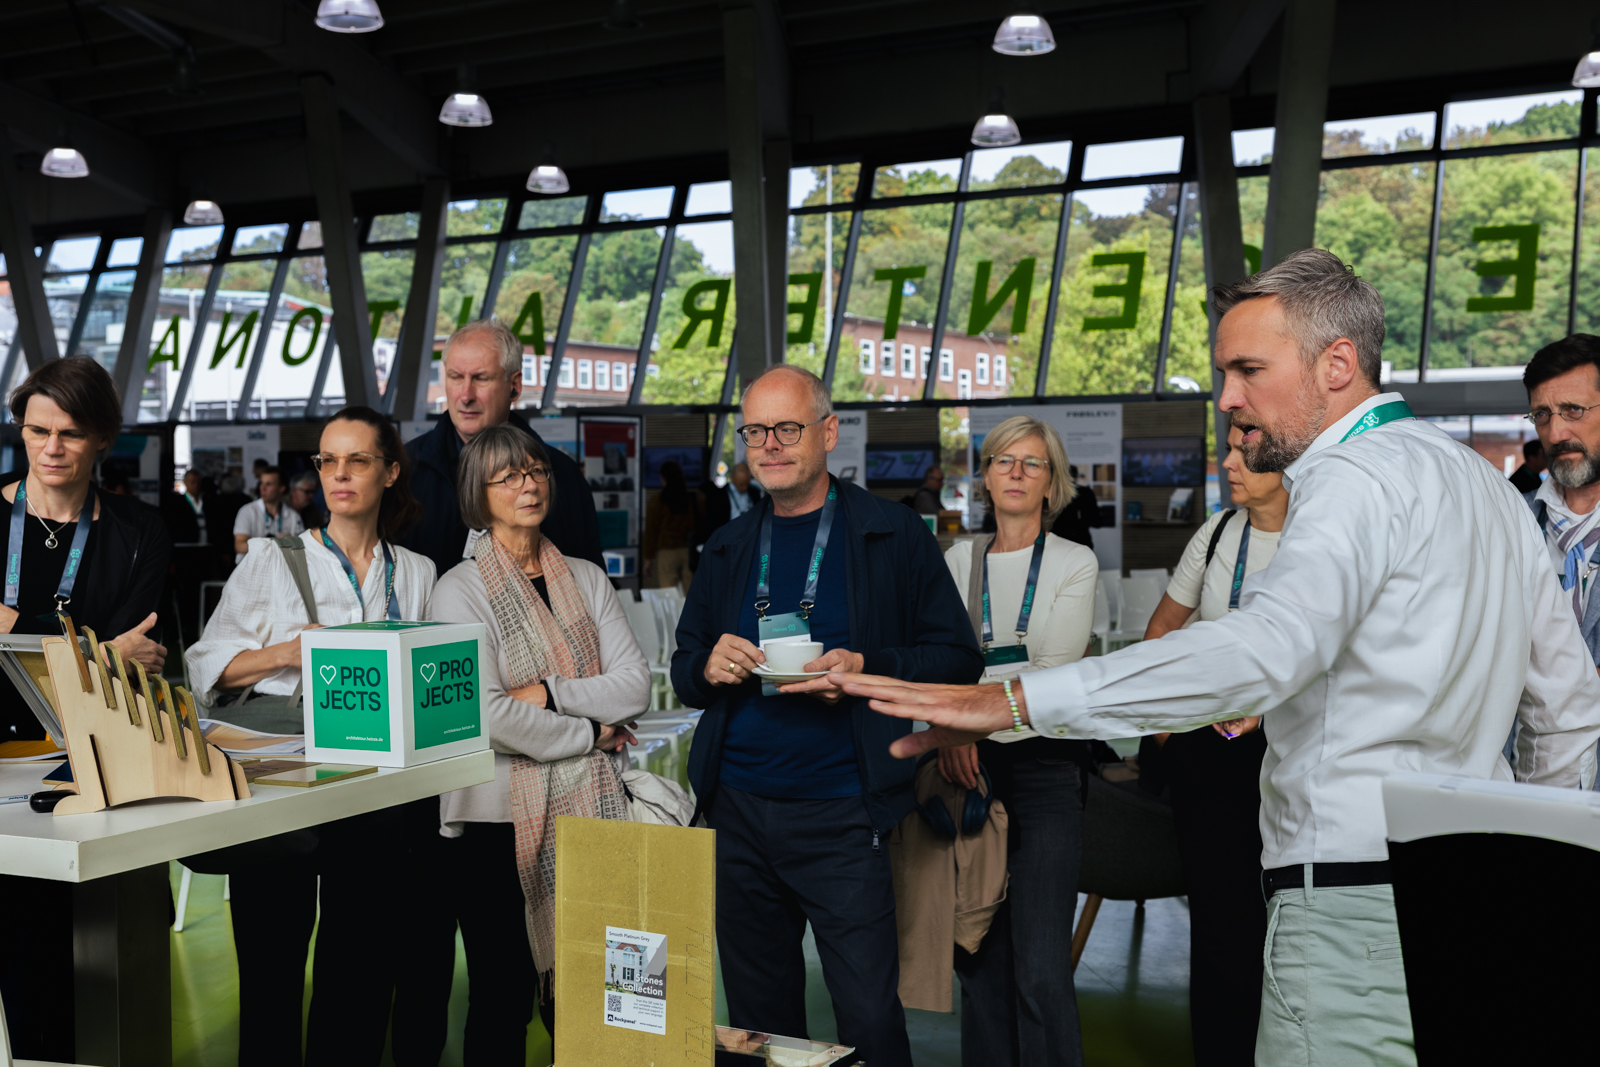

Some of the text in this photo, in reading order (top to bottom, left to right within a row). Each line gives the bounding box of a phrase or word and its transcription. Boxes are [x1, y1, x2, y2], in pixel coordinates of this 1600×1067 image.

[811, 548, 823, 571] Heinze
[340, 666, 381, 687] PRO
[439, 657, 474, 681] PRO
[319, 690, 381, 711] JECTS
[420, 681, 474, 708] JECTS
[622, 982, 663, 996] Collection
[635, 973, 663, 986] Stones
[614, 1016, 635, 1024] Rockpanel
